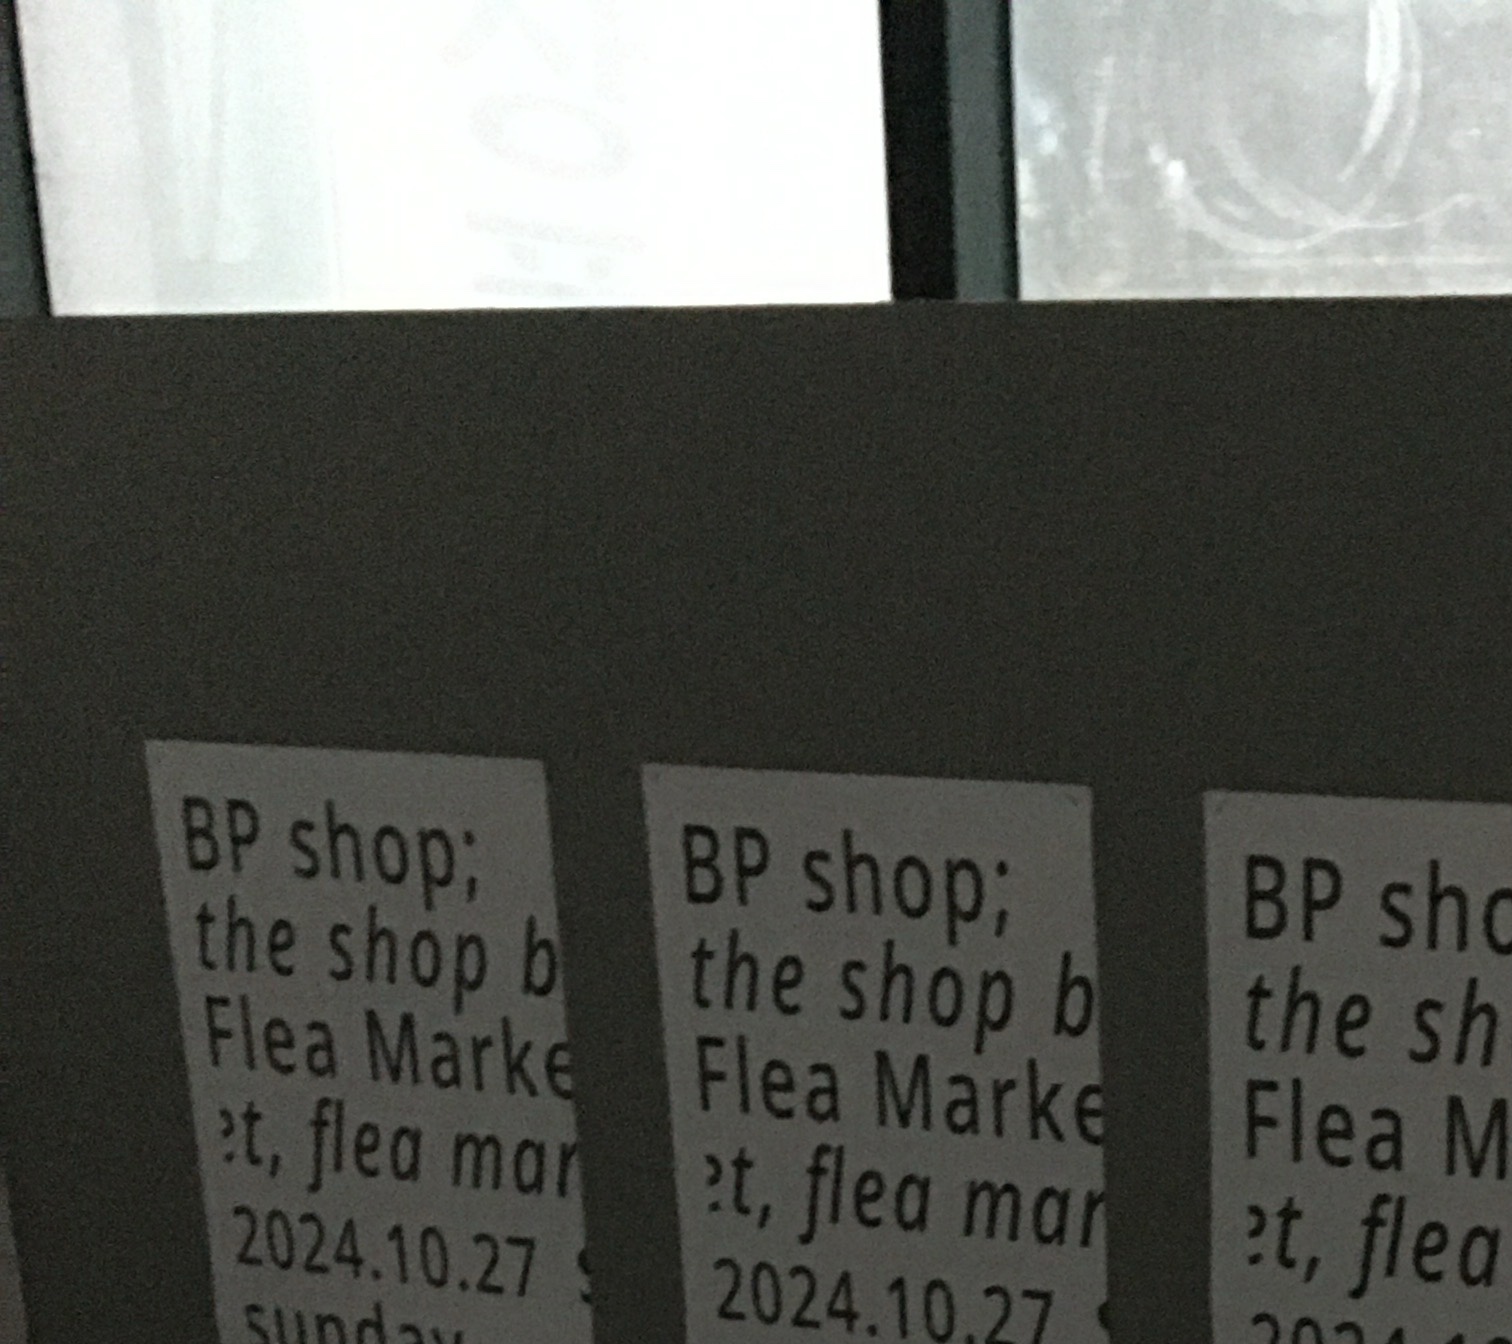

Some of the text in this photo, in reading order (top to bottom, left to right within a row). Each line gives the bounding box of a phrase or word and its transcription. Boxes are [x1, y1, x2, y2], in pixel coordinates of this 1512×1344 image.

[181, 795, 480, 909] BP shop;
[682, 824, 1009, 944] BP shop;
[1245, 854, 1343, 941] BP
[197, 895, 558, 1014] the shop b
[692, 930, 1093, 1053] the shop b
[205, 995, 574, 1098] Flea Marke
[1247, 966, 1371, 1057] the
[696, 1036, 1104, 1145] Flea Marke
[1246, 1080, 1403, 1171] Flea
[308, 1097, 422, 1192] flea
[452, 1129, 578, 1197] mar
[799, 1143, 929, 1245] flea
[963, 1177, 1104, 1248] mar
[232, 1205, 536, 1298] 2024.10.27
[1350, 1194, 1500, 1299] flea
